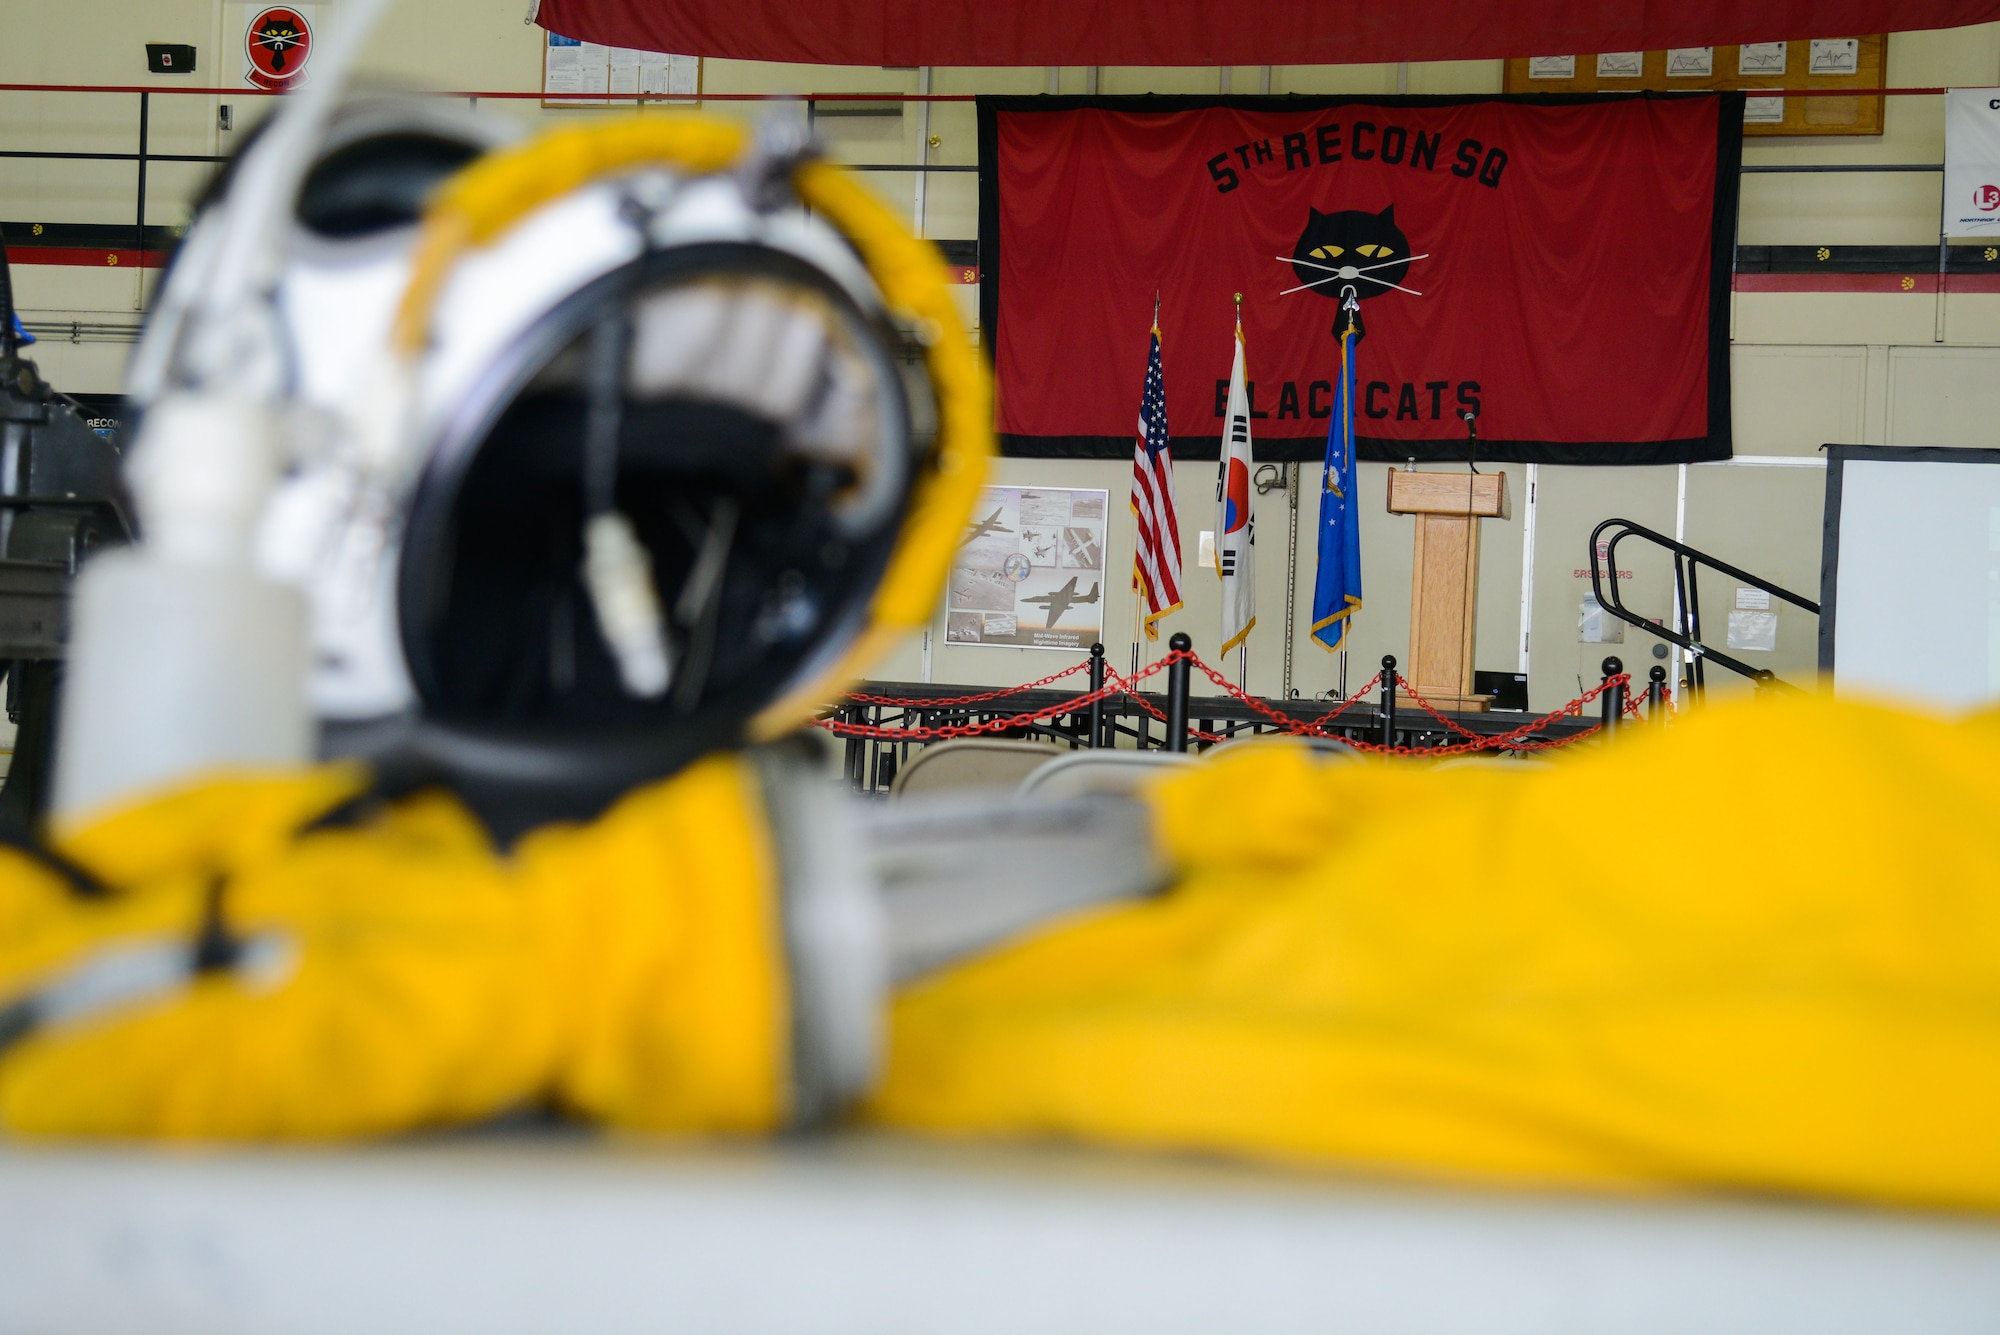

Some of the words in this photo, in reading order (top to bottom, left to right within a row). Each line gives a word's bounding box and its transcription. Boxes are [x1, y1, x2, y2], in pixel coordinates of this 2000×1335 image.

[1206, 139, 1274, 194] 5TH
[1282, 121, 1442, 171] RECON
[1451, 138, 1508, 190] SQ
[86, 418, 122, 429] RECON
[1033, 632, 1058, 640] Mid-Wave
[1059, 633, 1080, 641] Infrared
[1033, 639, 1058, 647] Nighttime
[1058, 640, 1080, 648] Imagery
